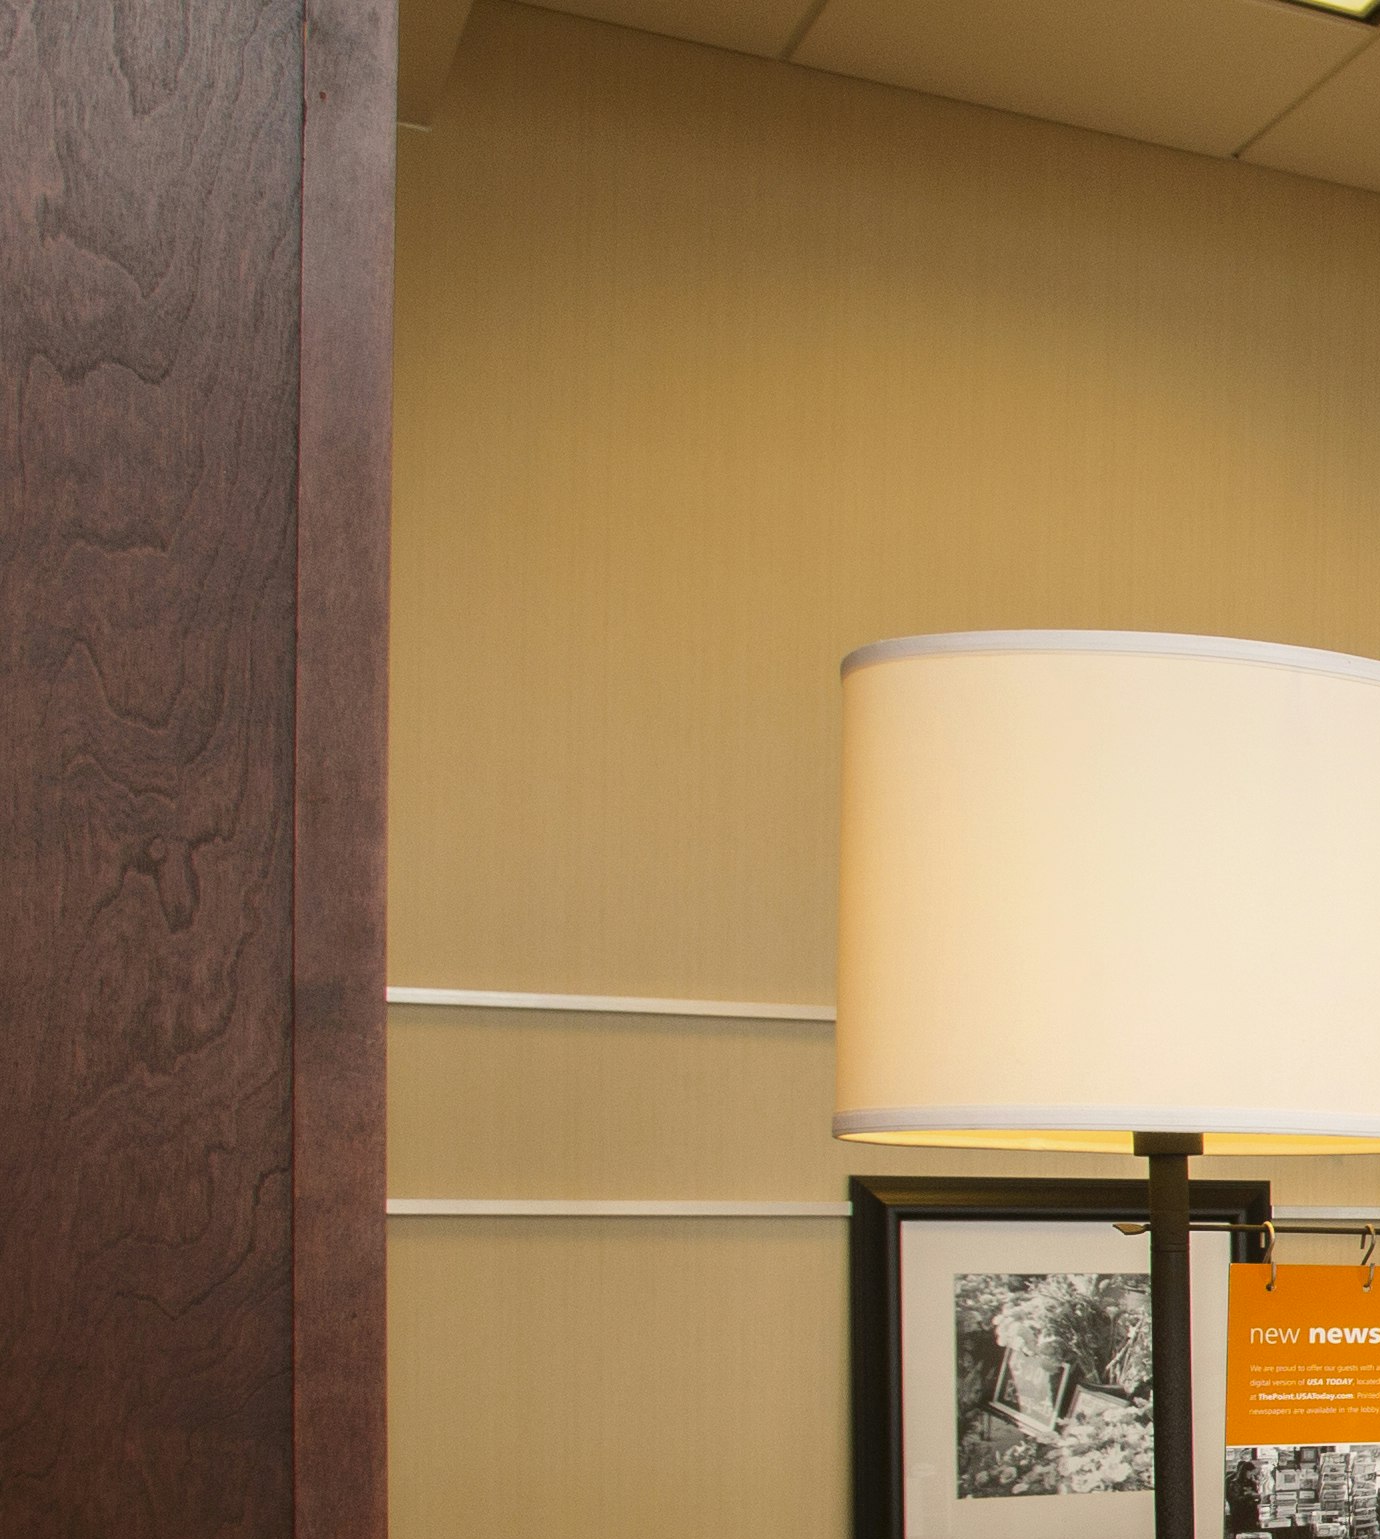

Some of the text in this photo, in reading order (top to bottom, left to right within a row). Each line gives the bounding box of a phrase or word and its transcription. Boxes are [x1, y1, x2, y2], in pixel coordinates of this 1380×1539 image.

[1250, 1327, 1300, 1344] new
[1276, 1365, 1296, 1373] proud
[1337, 1365, 1358, 1373] guests
[1250, 1379, 1270, 1388] digital
